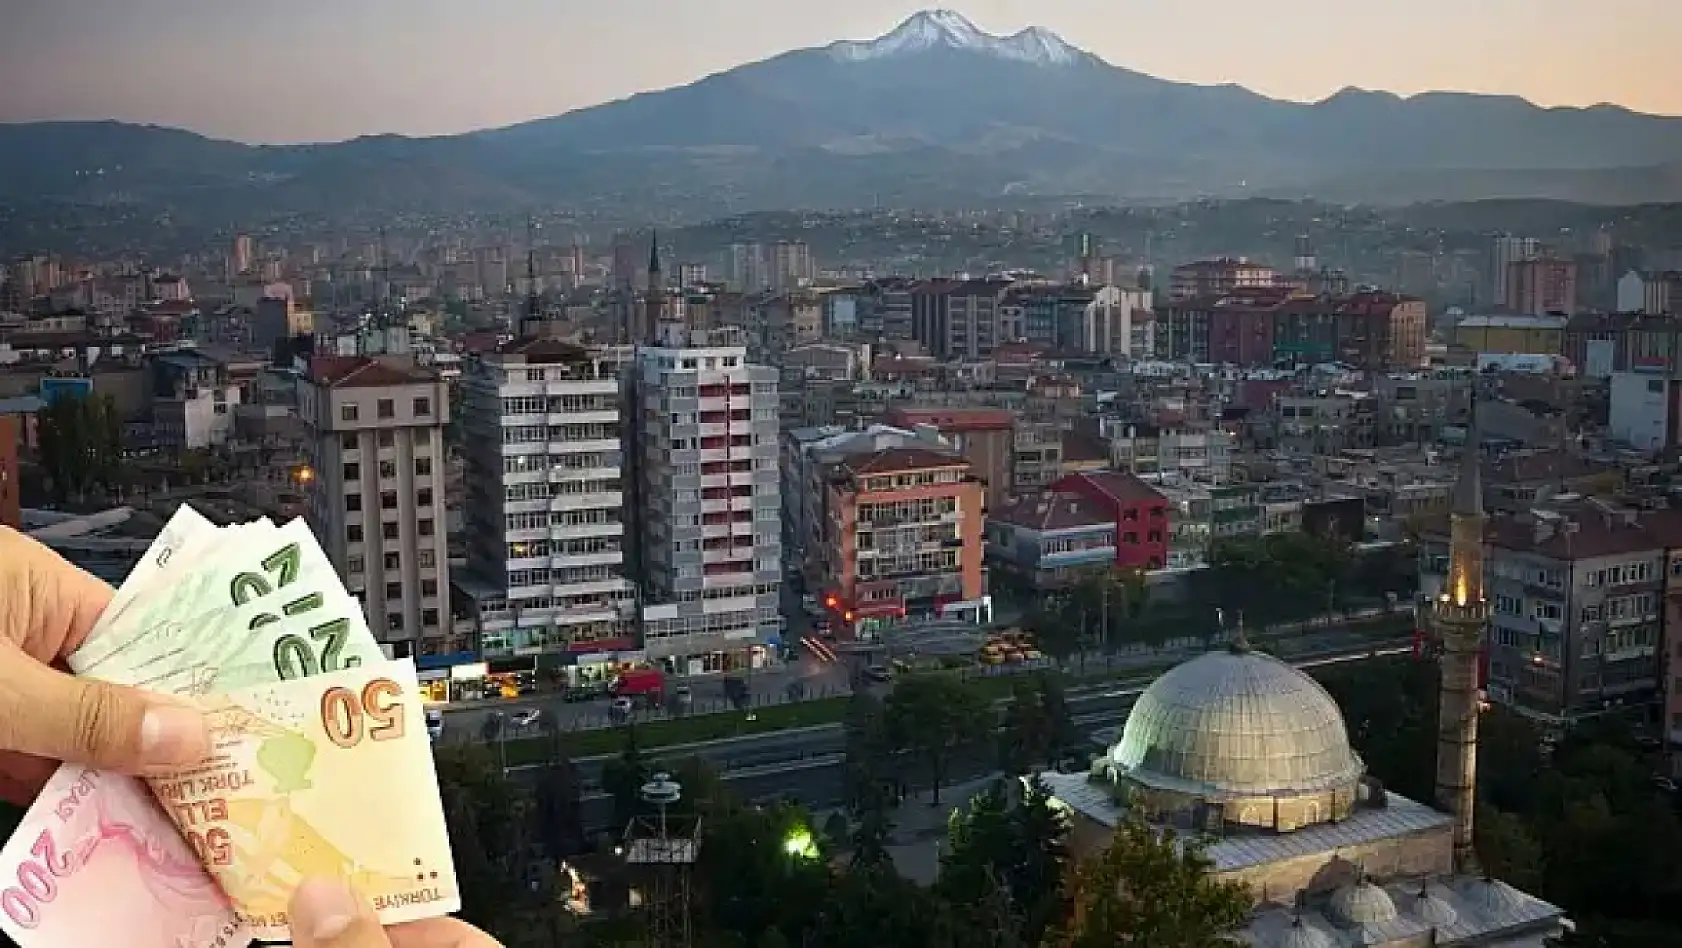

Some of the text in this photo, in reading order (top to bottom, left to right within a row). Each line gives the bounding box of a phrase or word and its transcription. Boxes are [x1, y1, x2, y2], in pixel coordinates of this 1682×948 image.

[272, 617, 361, 681] 20
[320, 678, 406, 748] 50
[2, 828, 73, 930] 200
